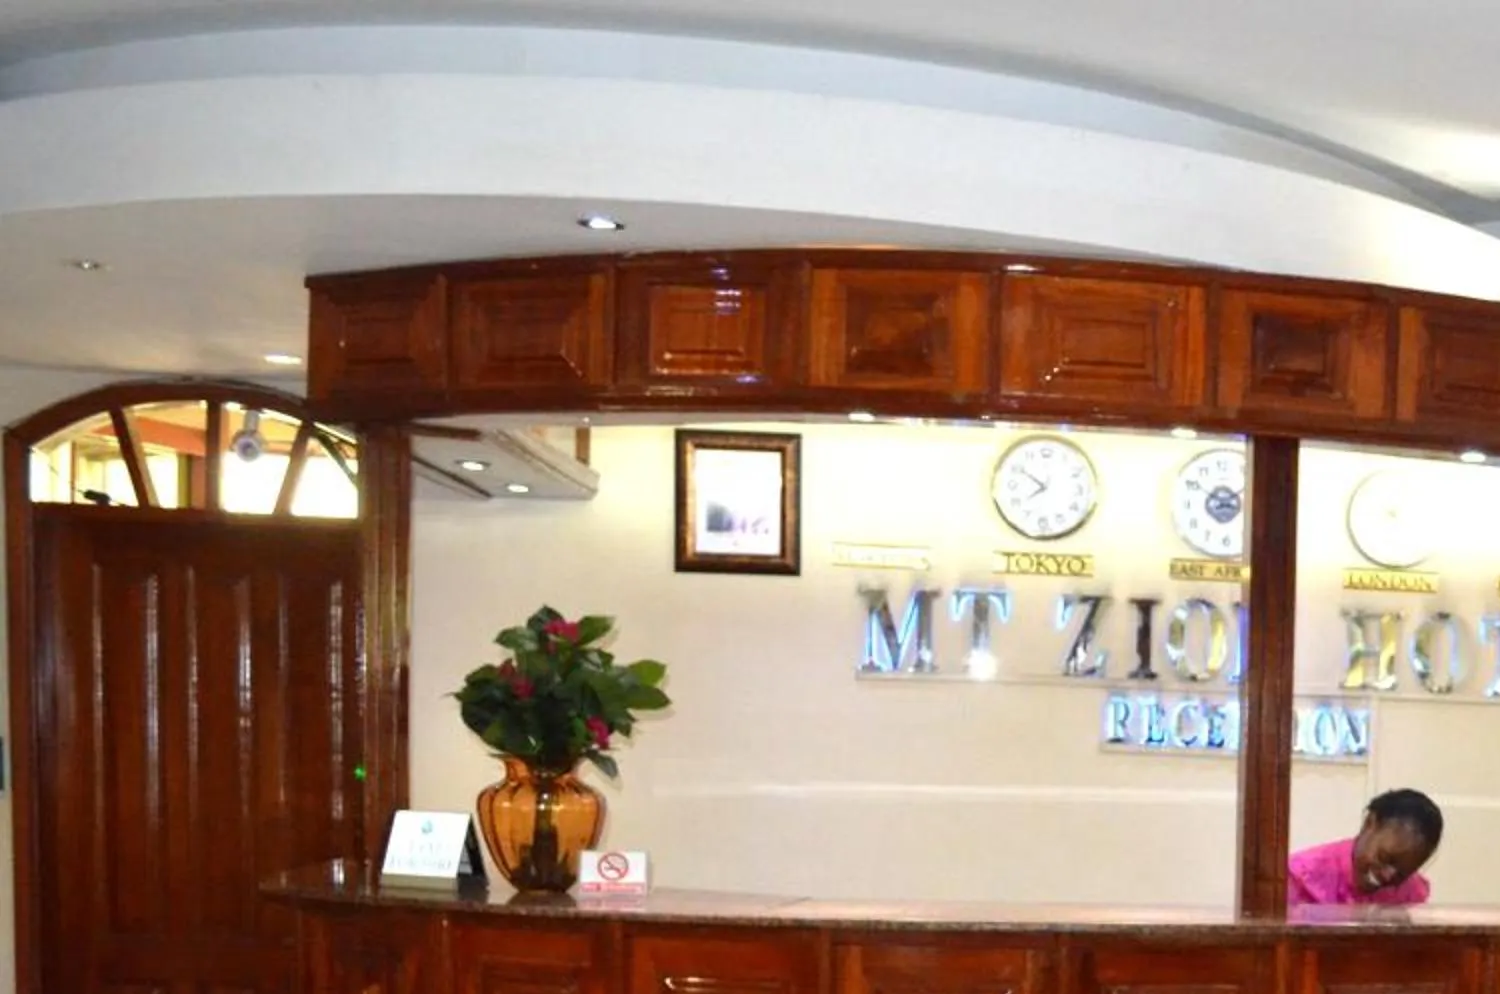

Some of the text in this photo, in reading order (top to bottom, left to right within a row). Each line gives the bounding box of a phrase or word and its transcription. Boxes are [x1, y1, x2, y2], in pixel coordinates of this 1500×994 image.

[1003, 553, 1086, 576] TOKYO
[1170, 562, 1244, 578] EAST AFR
[1350, 573, 1433, 591] LONDON
[856, 588, 1011, 677] MT
